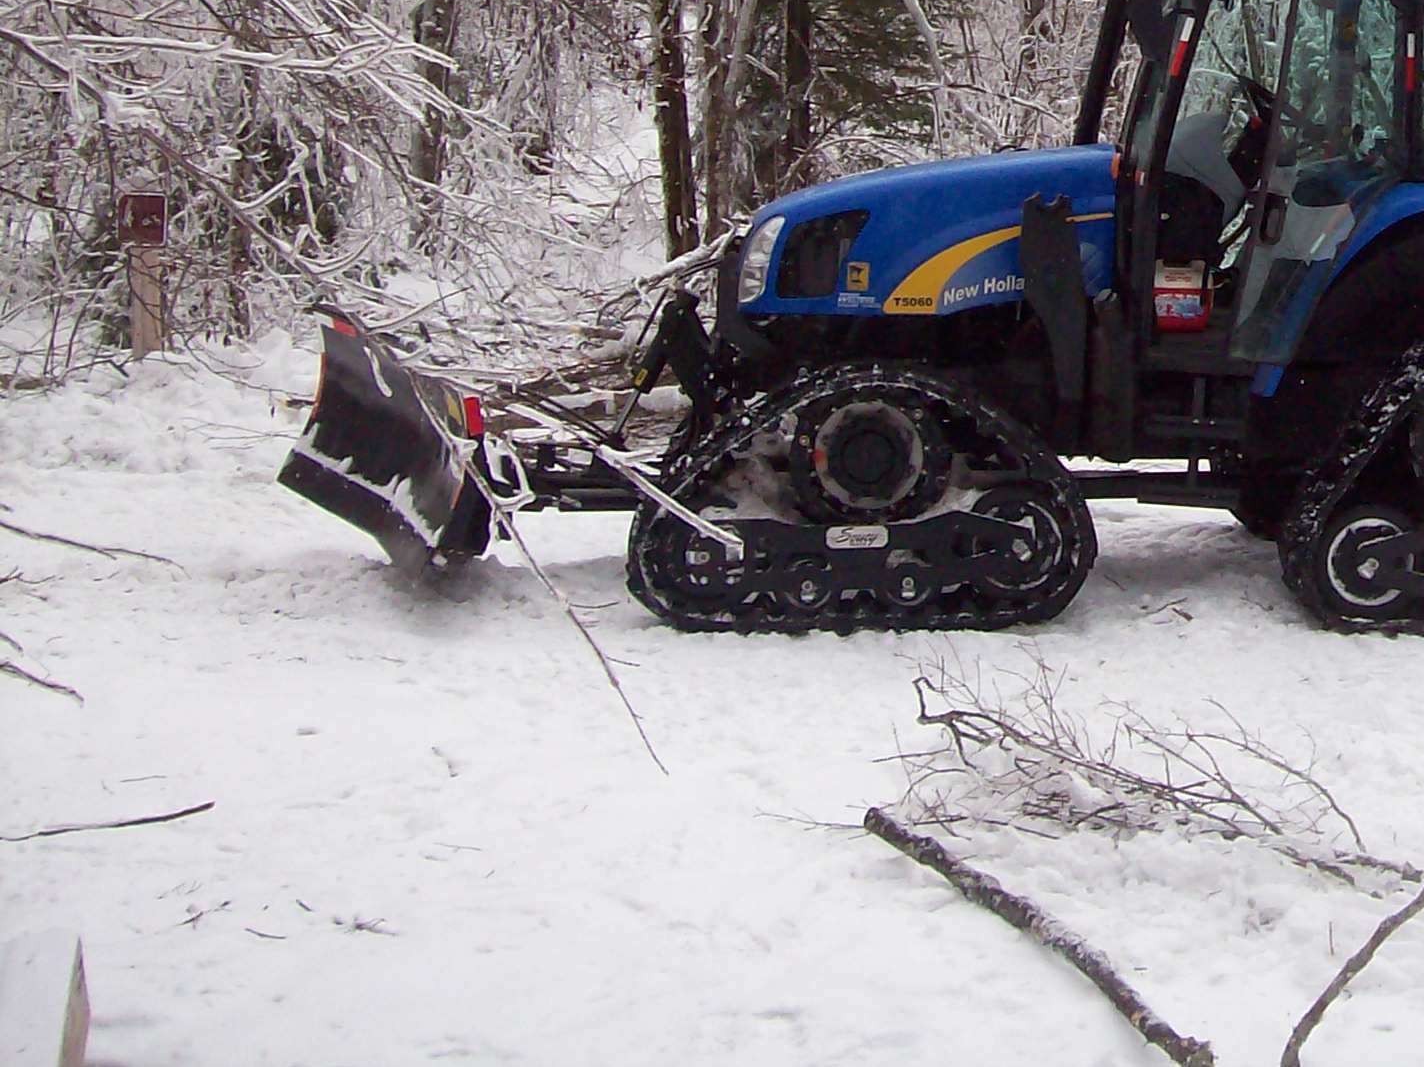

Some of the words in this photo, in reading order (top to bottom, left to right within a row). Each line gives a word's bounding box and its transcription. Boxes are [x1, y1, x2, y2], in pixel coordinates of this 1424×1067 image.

[944, 284, 979, 306] New
[984, 275, 1025, 294] Holla
[893, 297, 933, 307] T5060
